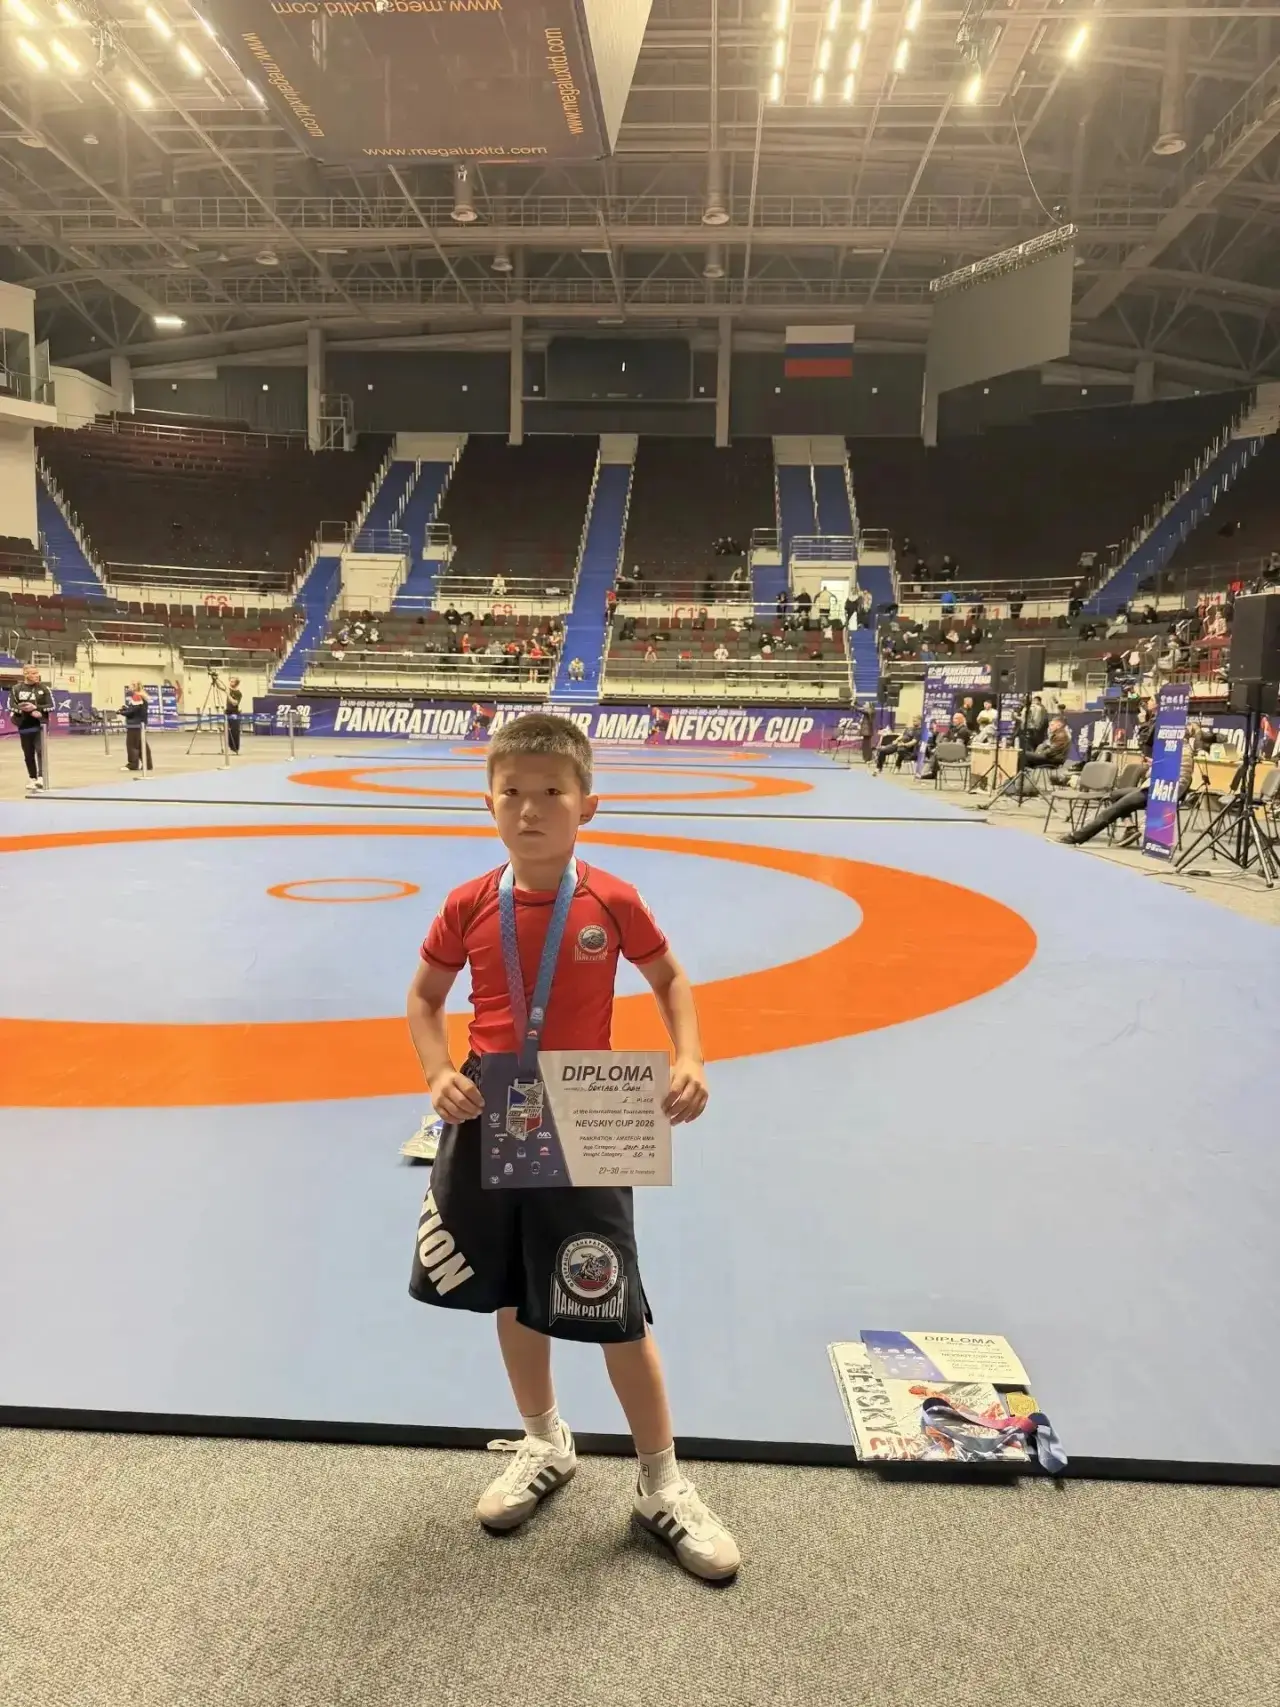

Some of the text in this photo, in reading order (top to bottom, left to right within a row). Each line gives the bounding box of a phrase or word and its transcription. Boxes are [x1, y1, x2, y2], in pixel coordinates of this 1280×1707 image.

[241, 32, 325, 137] www.megaluxltd.com
[544, 27, 582, 136] www.megaluxltd.com
[362, 146, 548, 157] www.megaluxltd.com
[334, 707, 471, 735] PANKRATION
[595, 714, 651, 739] MMA
[665, 715, 761, 742] NEVSKIY
[764, 717, 814, 743] CUP
[1151, 778, 1173, 802] Mat
[562, 1065, 653, 1081] DIPLOMA
[575, 1119, 655, 1128] NEVSKIY CUP 2026
[553, 1279, 625, 1318] ПАНКРАТИОН
[924, 1336, 996, 1345] DIPLOMA
